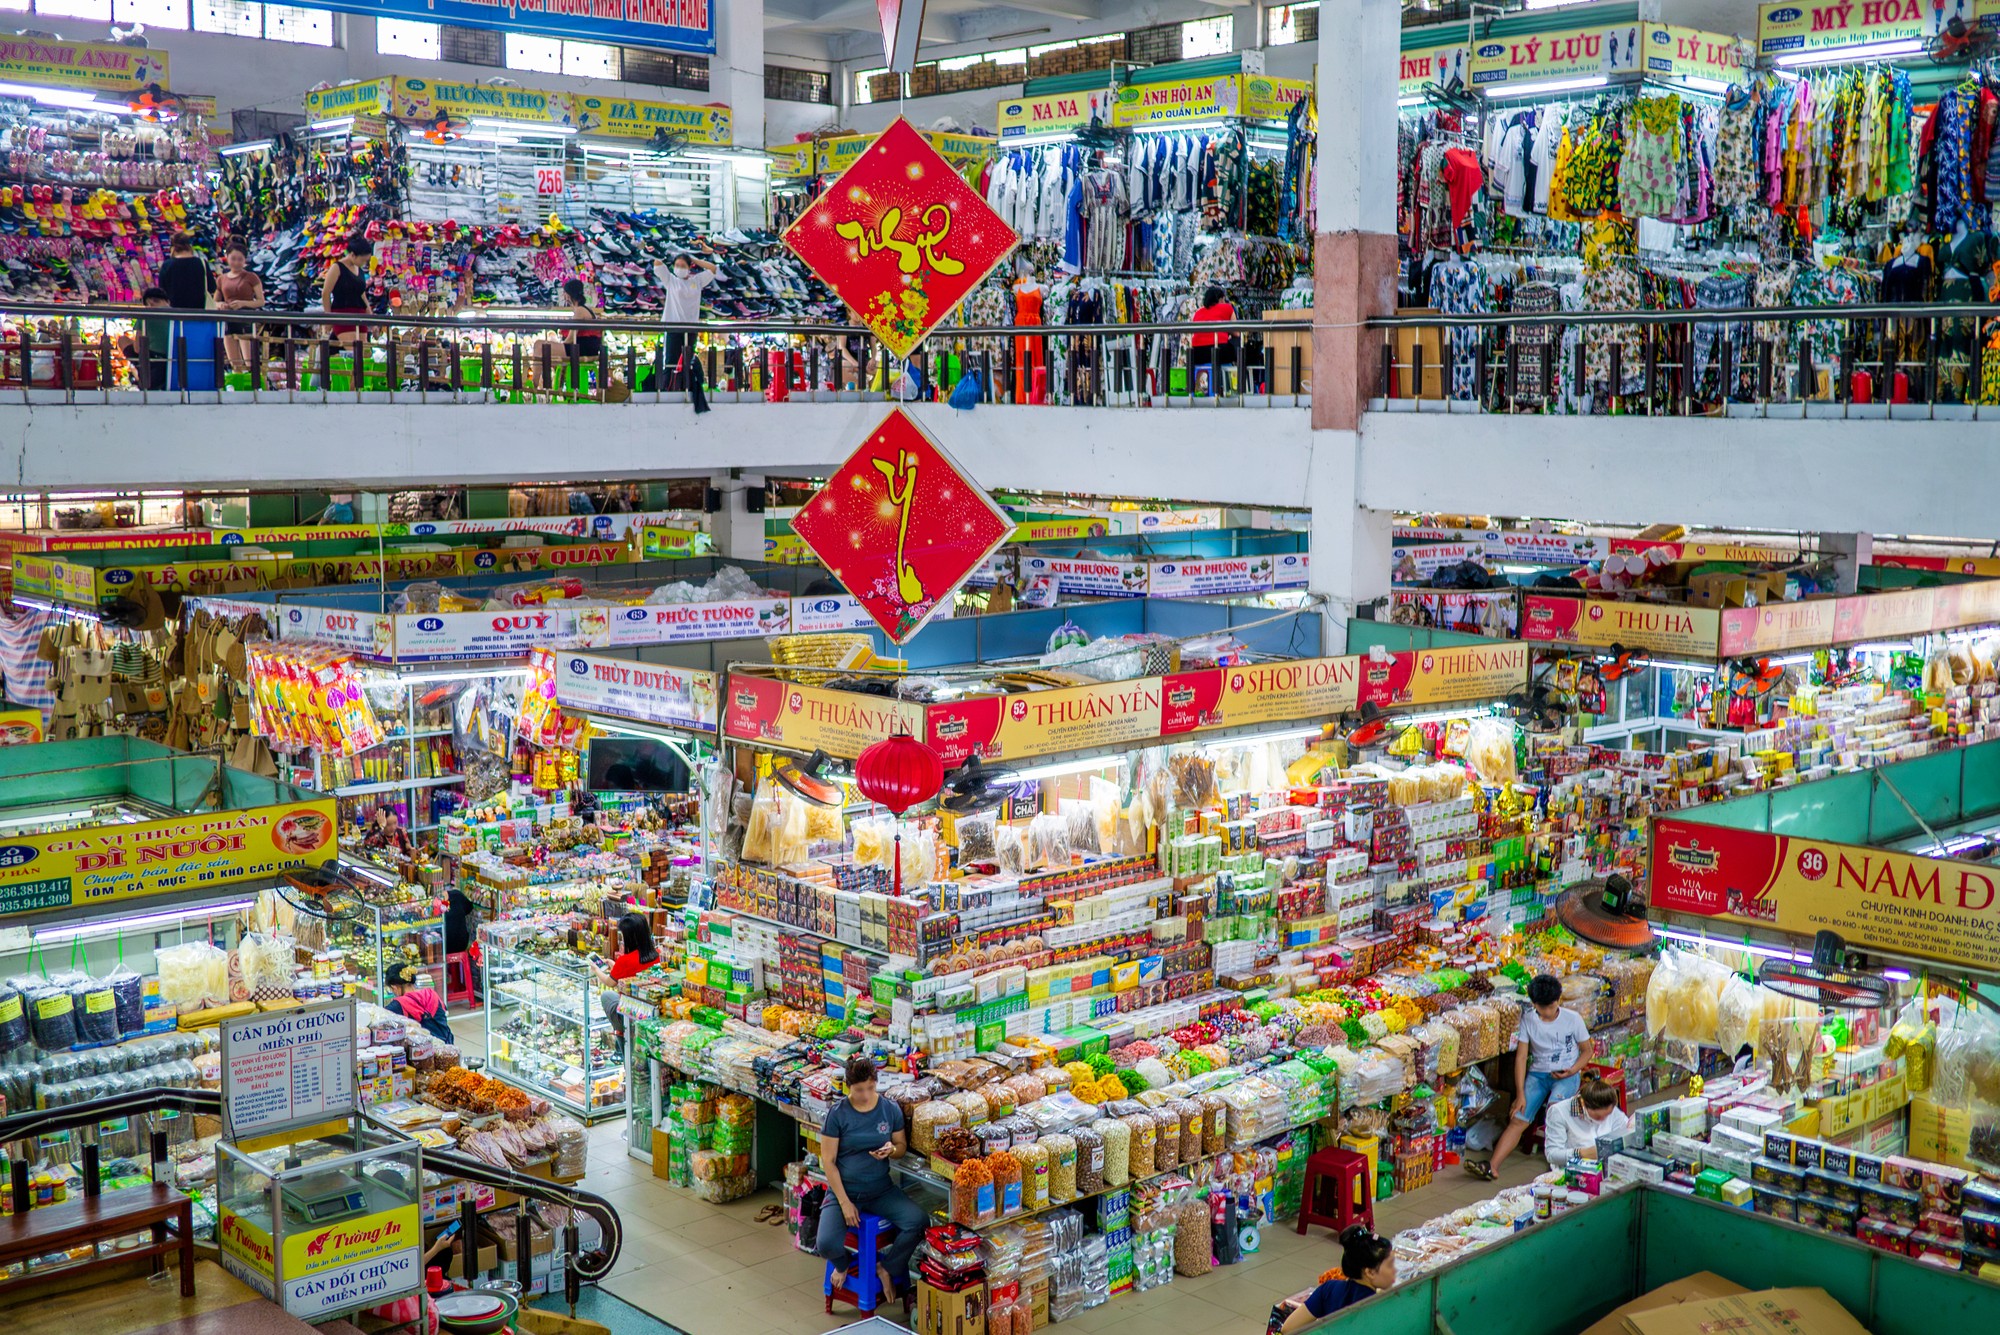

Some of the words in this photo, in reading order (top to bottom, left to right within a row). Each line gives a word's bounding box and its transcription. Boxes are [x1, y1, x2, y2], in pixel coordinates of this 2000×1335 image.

[1895, 25, 1922, 40] Trang
[78, 47, 132, 71] ANH
[1399, 52, 1432, 80] ÍNH
[1195, 84, 1213, 101] AN
[643, 105, 705, 127] TRINH
[1032, 103, 1054, 122] NA
[1057, 98, 1080, 118] NA
[1194, 104, 1221, 116] LANH
[538, 169, 563, 194] 256
[1725, 547, 1748, 561] KIM
[1747, 548, 1780, 561] ANH
[478, 557, 493, 567] 74
[1050, 561, 1072, 574] KIM
[1181, 563, 1204, 576] KIM
[111, 574, 128, 583] 76
[820, 600, 836, 612] 62
[631, 610, 644, 619] 63
[1614, 610, 1662, 632] THU
[1664, 609, 1695, 634] HÀ
[1777, 610, 1805, 630] THU
[424, 619, 437, 630] 64
[574, 659, 584, 673] 53
[1489, 649, 1525, 672] ANH
[1233, 675, 1242, 688] 51
[1247, 663, 1303, 695] SHOP
[1305, 659, 1355, 688] LOAN
[791, 694, 801, 707] 52
[1014, 702, 1026, 715] 52
[1118, 683, 1160, 714] YẾN
[1066, 724, 1079, 734] KINH
[46, 838, 91, 855] GIA
[1675, 853, 1690, 863] KING
[1690, 855, 1712, 866] COFFEE
[1802, 851, 1823, 871] 36
[83, 871, 135, 887] Chuyên
[1682, 878, 1702, 890] VUA
[1834, 851, 1946, 906] NAM
[84, 885, 115, 898] TÔM
[1860, 899, 1903, 916] CHUYÊN
[1903, 907, 1927, 920] KINH
[1928, 910, 1970, 927] DOANH:
[1970, 916, 1995, 934] ĐẶC
[1894, 918, 1904, 927] BIA
[1902, 939, 1919, 949] 0236
[1938, 945, 1948, 954] 115
[1952, 948, 1971, 958] 0236
[1971, 951, 1989, 961] 3893
[232, 1026, 263, 1042] CÂN
[267, 1017, 292, 1036] ĐỐI
[296, 1011, 345, 1030] CHỨNG
[230, 1060, 242, 1068] QUY
[236, 1075, 254, 1085] TRONG
[244, 1098, 256, 1106] CHO
[332, 1226, 381, 1250] Tường
[378, 1219, 402, 1241] An
[384, 1238, 403, 1252] ngon!
[294, 1278, 326, 1299] CÂN
[329, 1268, 355, 1289] ĐỐI
[359, 1256, 410, 1281] CHỨNG
